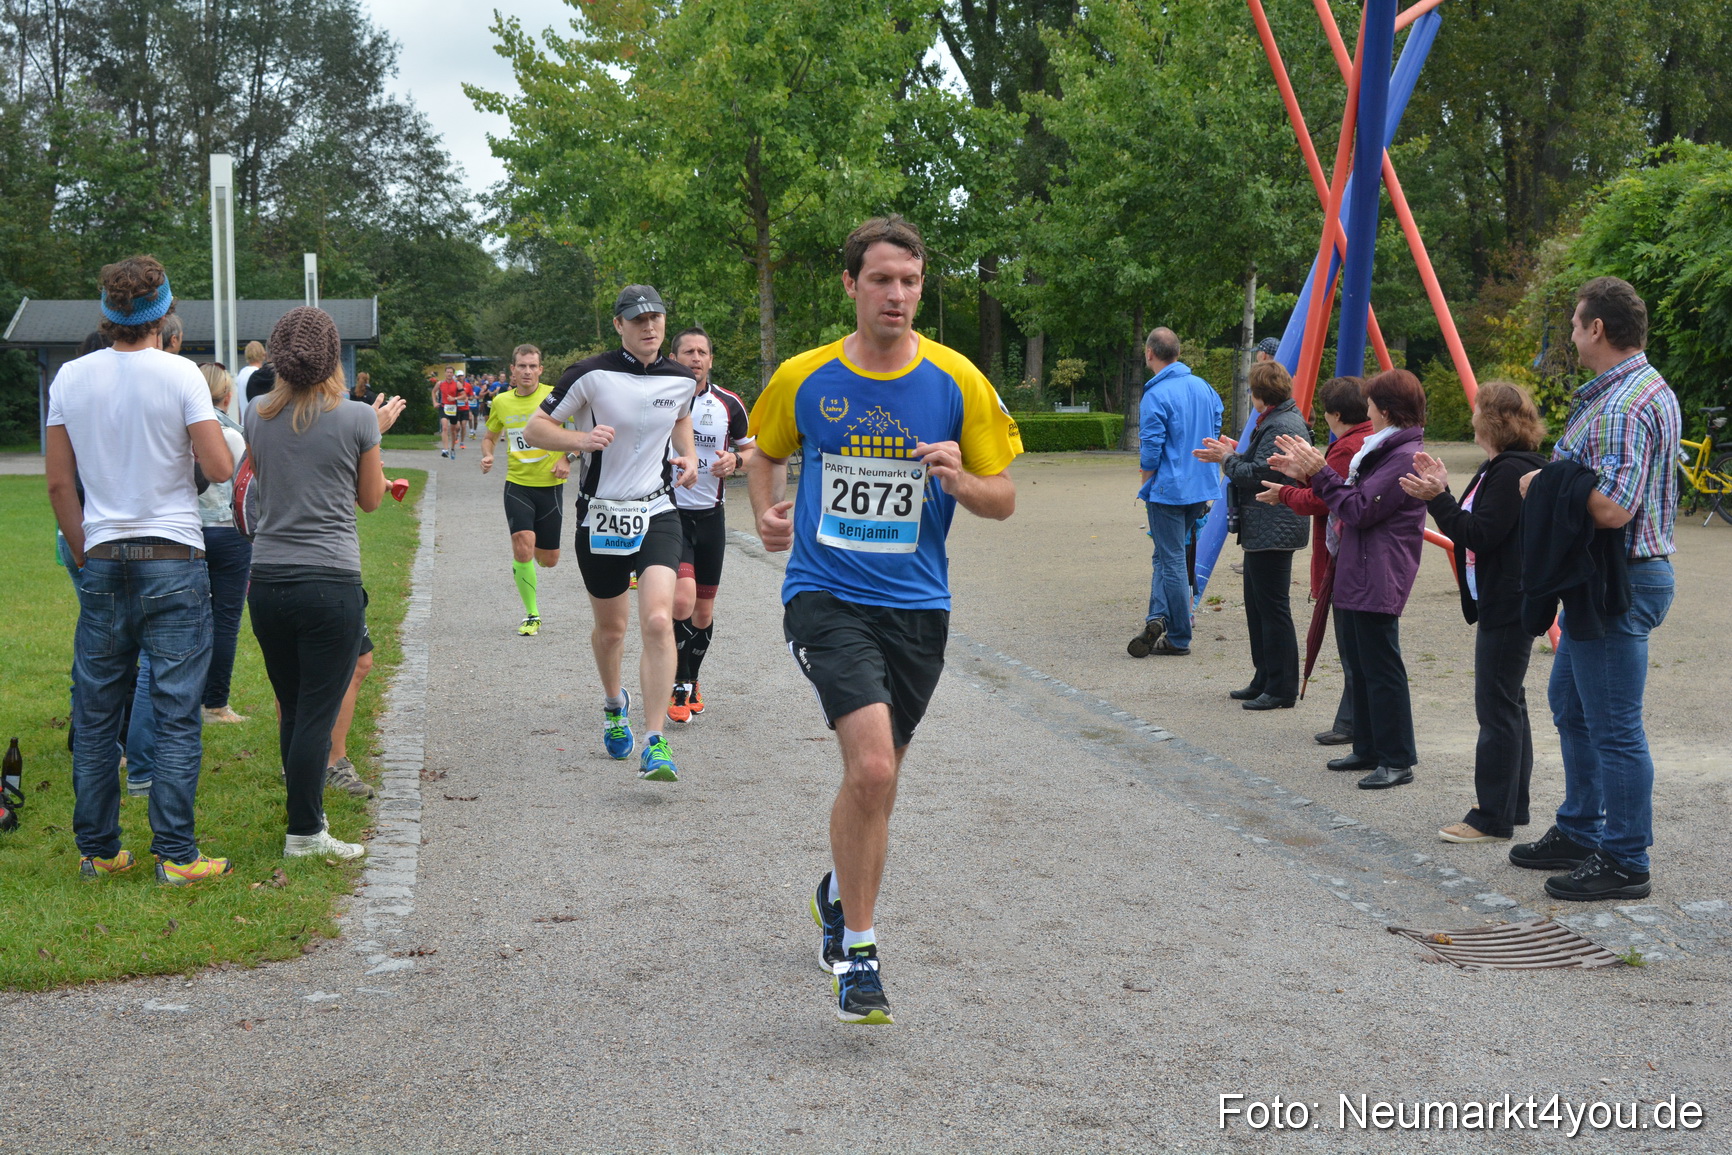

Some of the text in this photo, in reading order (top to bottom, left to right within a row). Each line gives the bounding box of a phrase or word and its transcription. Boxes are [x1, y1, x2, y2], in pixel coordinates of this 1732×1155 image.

[622, 351, 637, 364] PEAK
[655, 399, 675, 407] PEAK
[824, 462, 907, 479] PARTL Neumarkt
[831, 478, 913, 517] 2673
[589, 504, 609, 512] PARTL
[596, 512, 644, 536] 2459
[838, 522, 899, 541] Benjamin
[605, 538, 635, 548] Andreas
[111, 546, 154, 559] PMA
